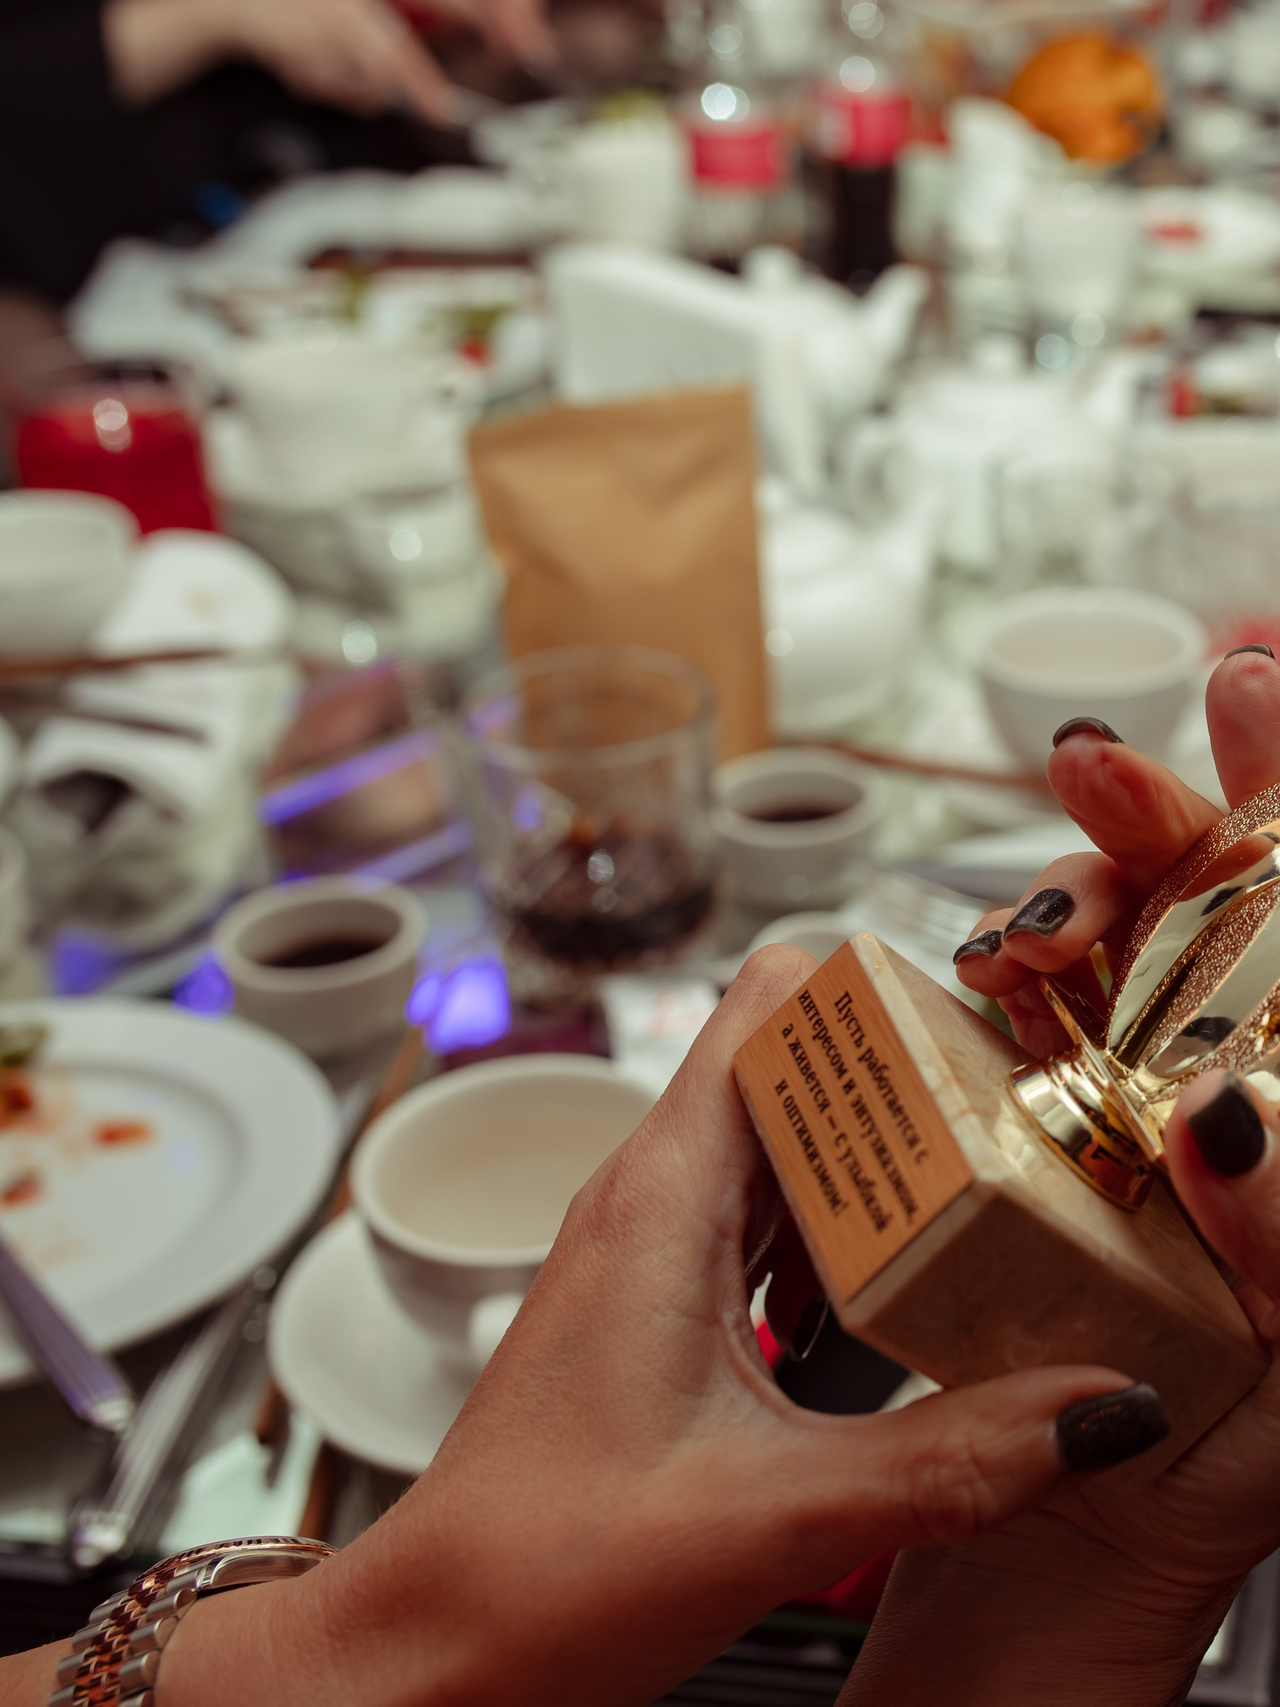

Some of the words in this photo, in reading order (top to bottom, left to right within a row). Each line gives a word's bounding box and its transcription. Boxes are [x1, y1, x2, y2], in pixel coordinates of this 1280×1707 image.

[781, 1023, 795, 1040] а
[798, 988, 848, 1079] интересом
[842, 1079, 855, 1094] и
[834, 990, 864, 1049] Пусть
[858, 1046, 923, 1151] работается
[788, 1037, 830, 1114] живется
[775, 1079, 788, 1097] и
[782, 1094, 849, 1218] оптимизмом!
[834, 1132, 848, 1146] с
[837, 1146, 892, 1233] улыбкой
